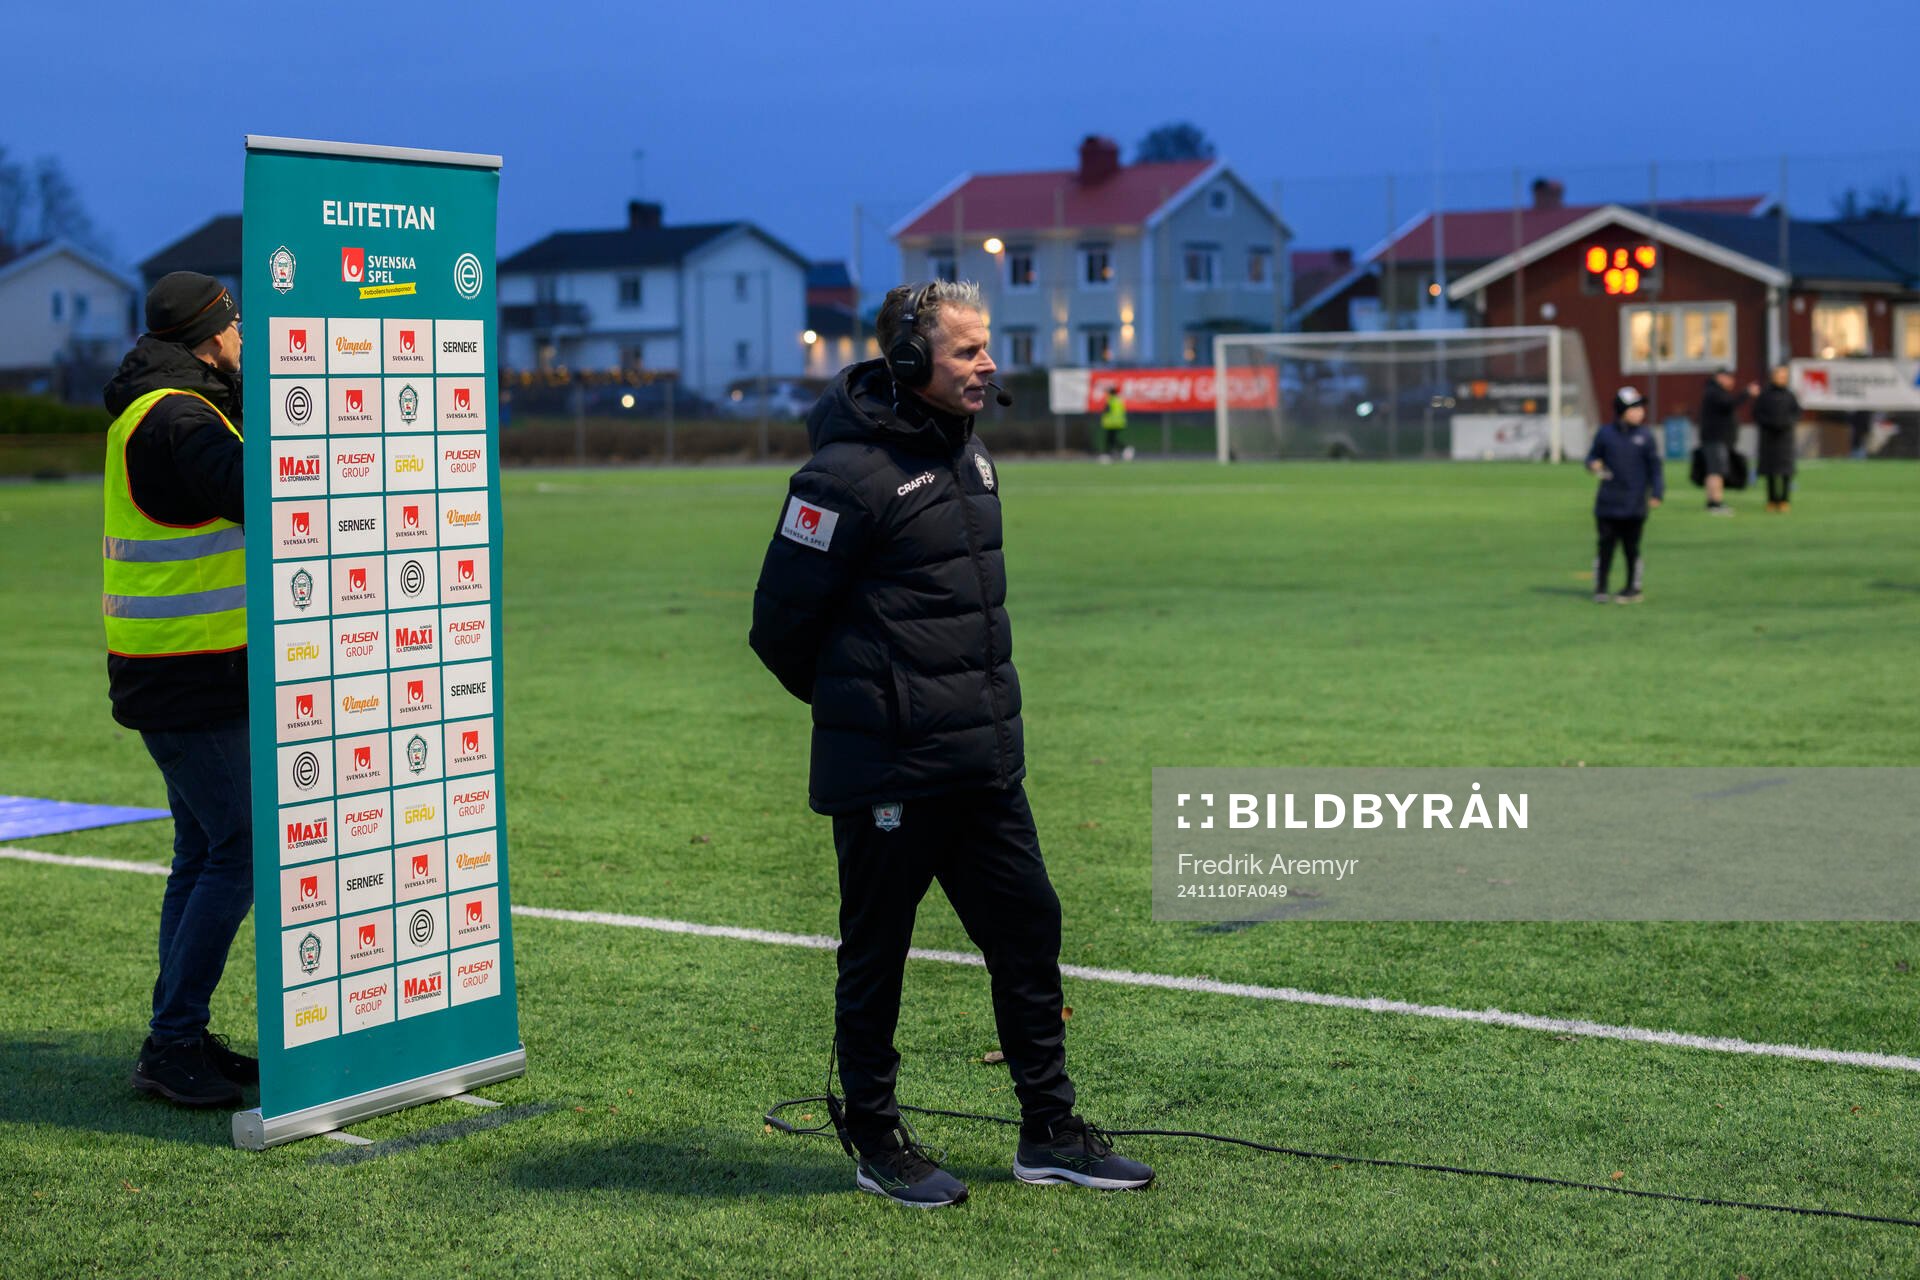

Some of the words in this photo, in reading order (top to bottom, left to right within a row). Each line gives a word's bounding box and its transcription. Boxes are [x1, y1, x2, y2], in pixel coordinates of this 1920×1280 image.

[322, 200, 435, 230] ELITETTAN
[368, 255, 416, 269] SVENSKA
[368, 269, 394, 283] SPEL
[335, 336, 373, 355] Vimpeln
[443, 342, 477, 352] SERNEKE
[337, 454, 375, 464] PULSEN
[445, 450, 481, 460] PULSEN
[342, 467, 369, 478] GROUP
[450, 463, 476, 473] GROUP
[897, 475, 927, 496] CRAFT
[446, 510, 481, 527] Vimpeln
[338, 519, 375, 532] SERNEKE
[810, 538, 826, 546] SPEL
[449, 620, 485, 632] PULSEN
[340, 631, 379, 644] PULSEN
[454, 634, 480, 645] GROUP
[346, 645, 374, 657] GROUP
[451, 682, 486, 696] SERNEKE
[342, 695, 379, 714] Vimpeln
[400, 706, 421, 714] SVENSKA
[287, 721, 310, 730] SVENSKA
[311, 719, 323, 727] SPEL
[454, 755, 476, 763] SVENSKA
[346, 773, 368, 782] SVENSKA
[453, 790, 489, 805] PULSEN
[345, 808, 383, 824] PULSEN
[459, 804, 485, 817] GROUP
[351, 822, 378, 837] GROUP
[456, 851, 491, 871] Vimpeln
[346, 873, 384, 891] SERNEKE
[404, 880, 425, 889] SVENSKA
[426, 878, 437, 886] SPEL
[291, 903, 314, 913] SVENSKA
[315, 900, 327, 909] SPEL
[458, 926, 479, 936] SVENSKA
[480, 923, 491, 932] SPEL
[350, 951, 372, 961] SVENSKA
[372, 948, 385, 957] SPEL
[457, 959, 493, 977] PULSEN
[463, 973, 488, 989] GROUP
[349, 983, 387, 1004] PULSEN
[355, 999, 382, 1015] GROUP
